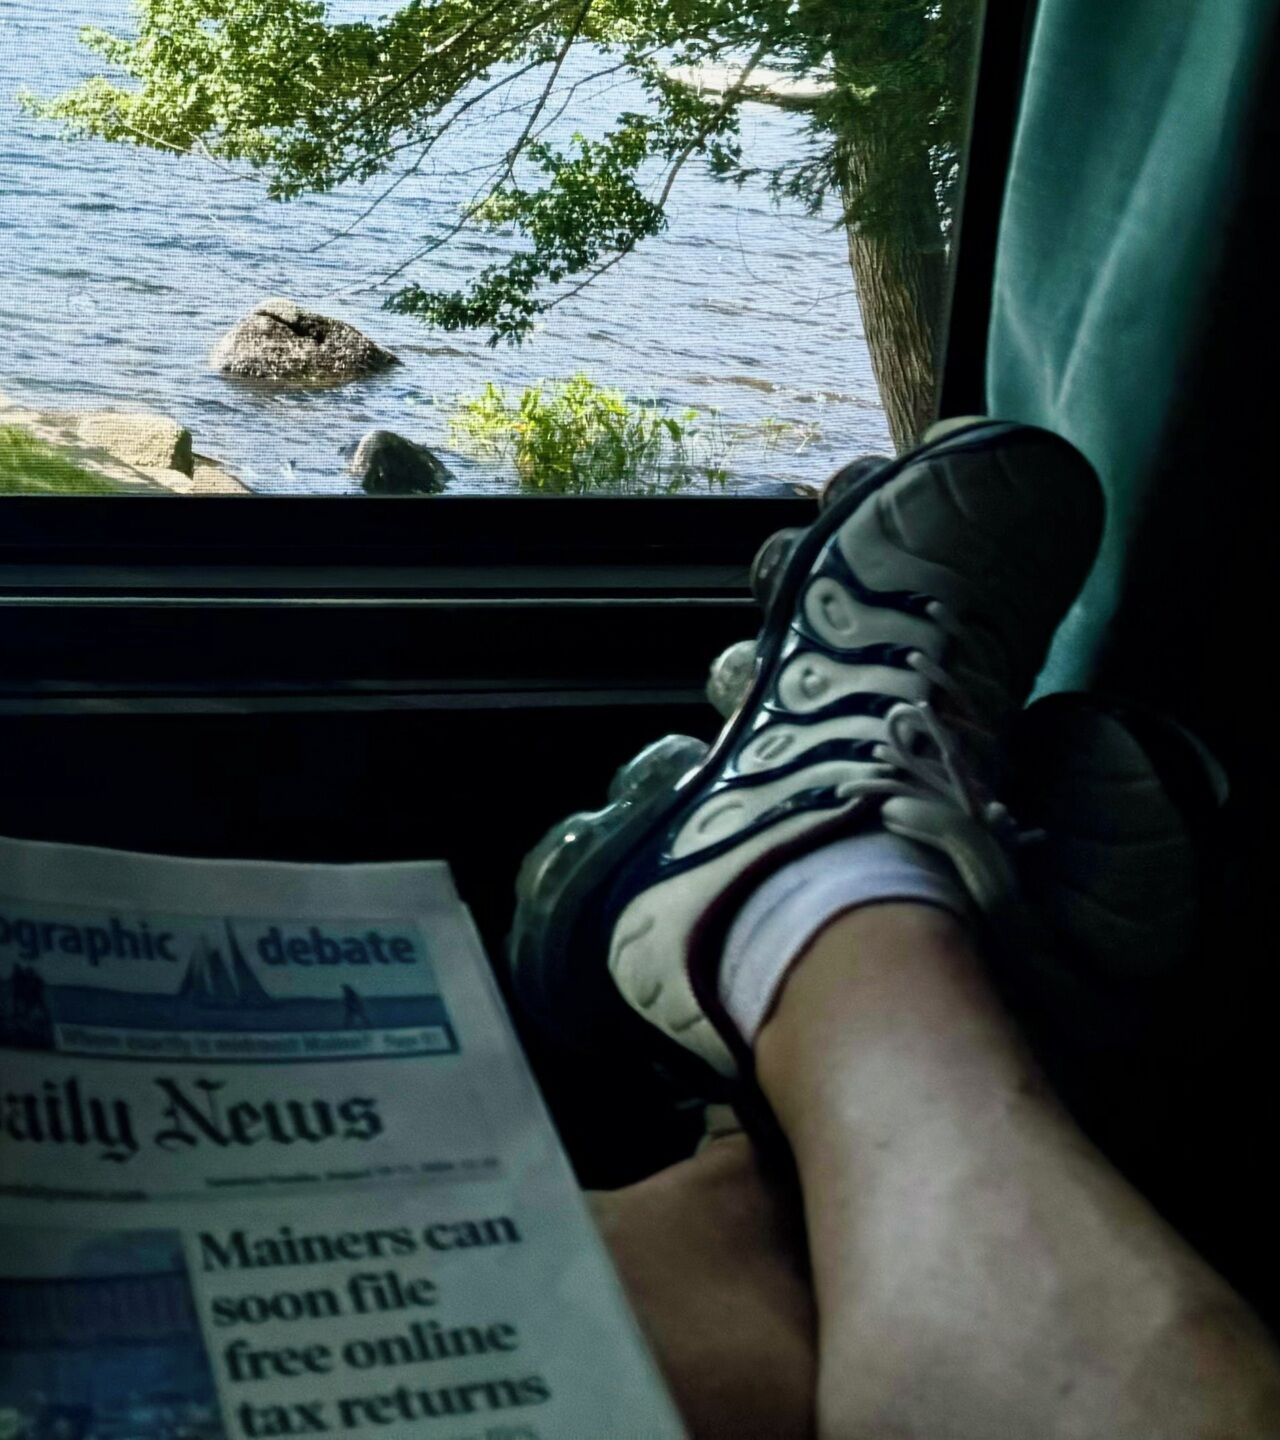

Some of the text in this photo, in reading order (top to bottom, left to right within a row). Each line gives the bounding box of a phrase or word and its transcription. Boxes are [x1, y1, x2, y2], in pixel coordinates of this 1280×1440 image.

[257, 926, 416, 965] debate
[155, 1077, 385, 1150] News
[198, 1214, 523, 1272] Mainers can
[211, 1270, 438, 1328] soon file
[223, 1320, 519, 1383] free online
[237, 1373, 552, 1438] tax returns
